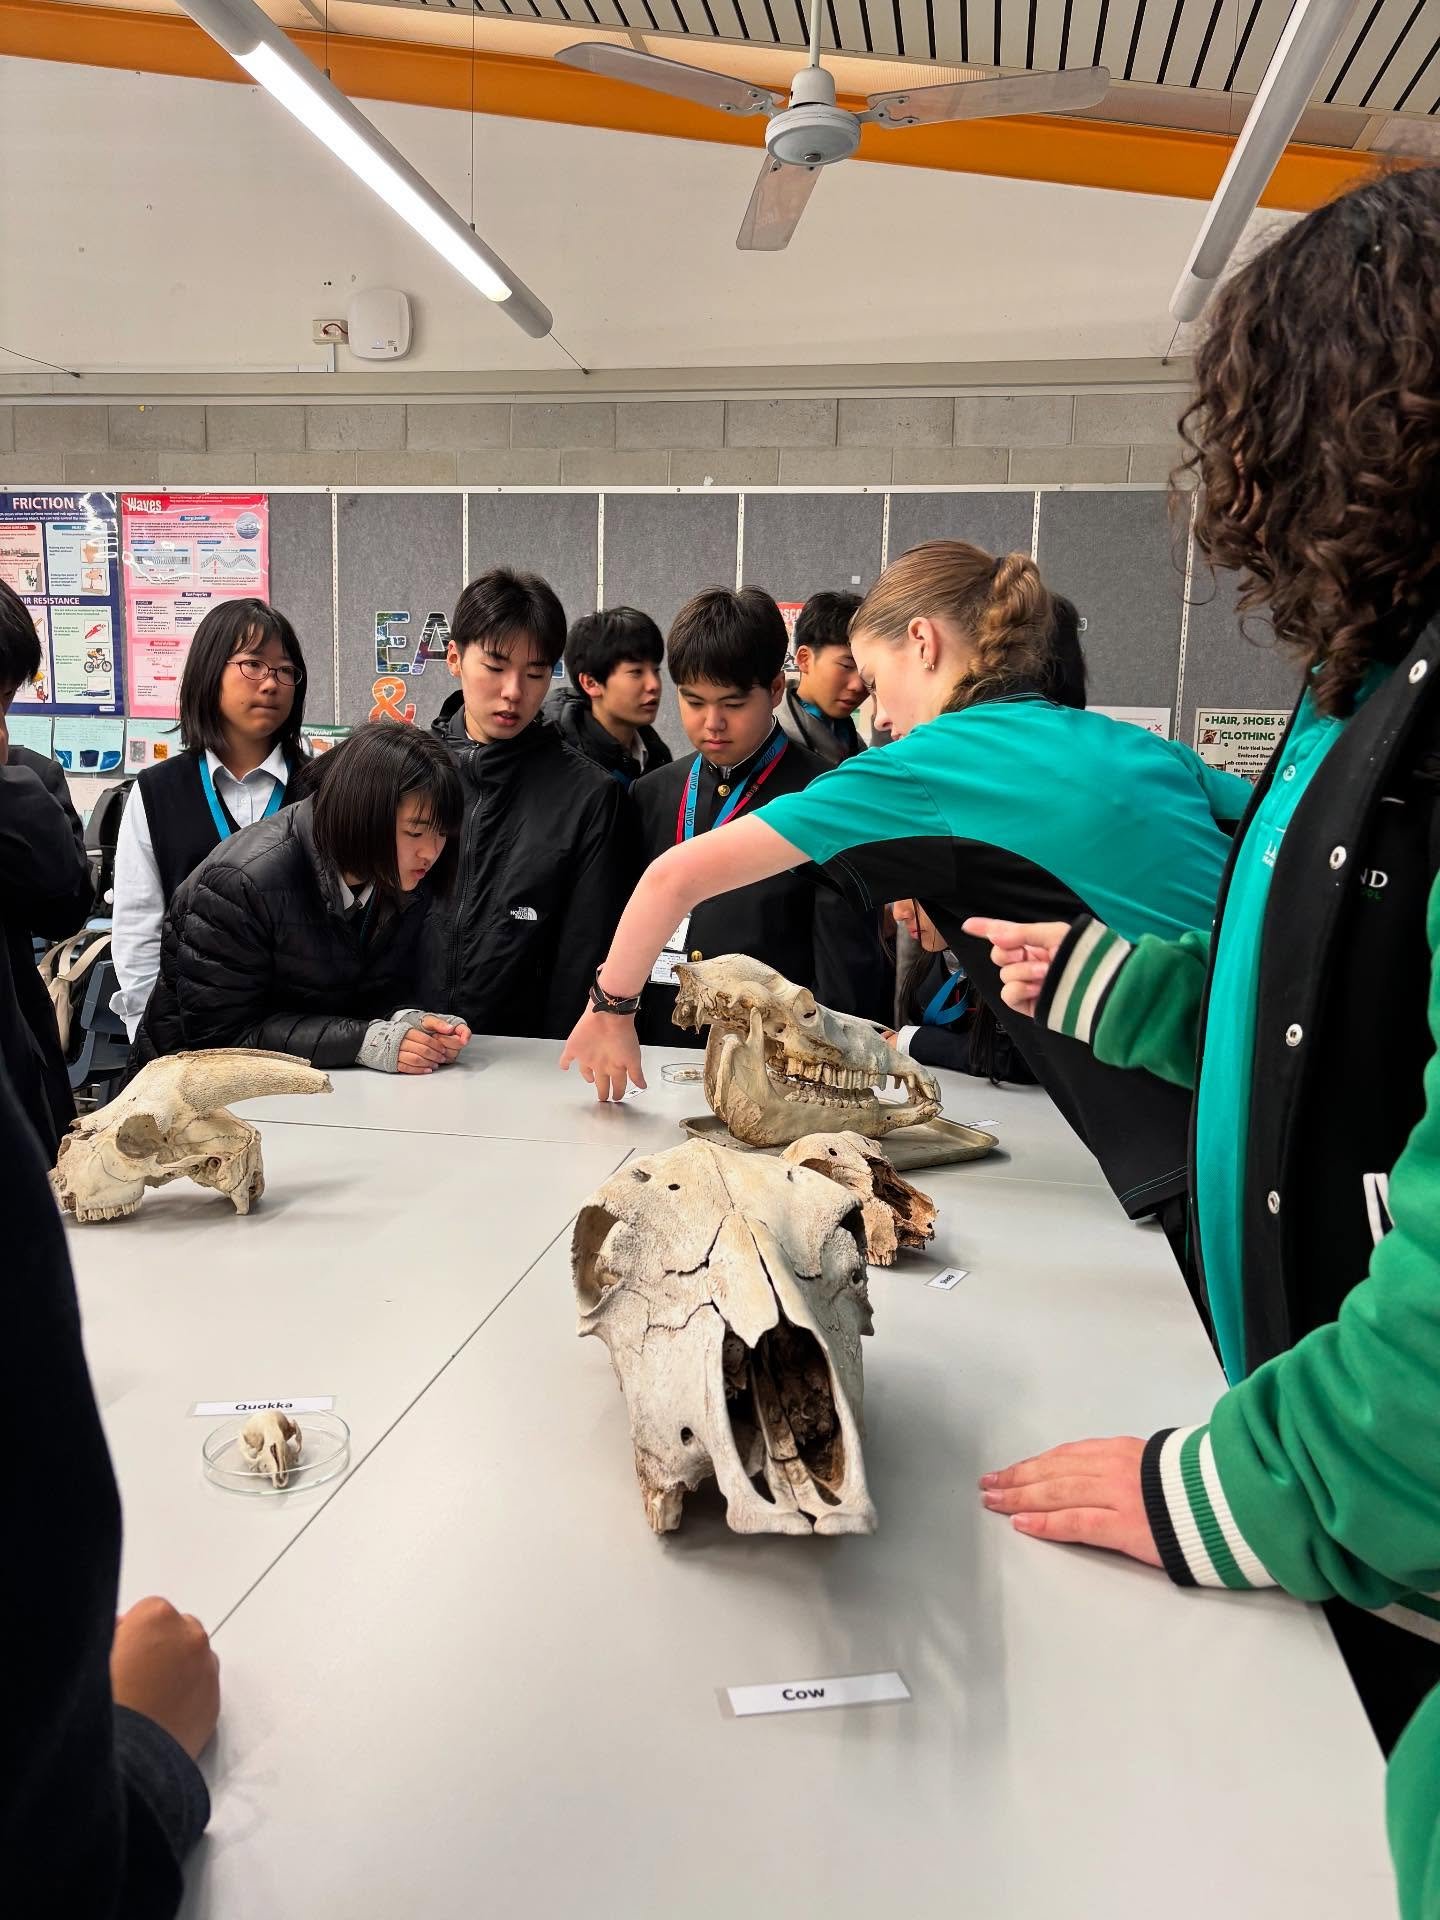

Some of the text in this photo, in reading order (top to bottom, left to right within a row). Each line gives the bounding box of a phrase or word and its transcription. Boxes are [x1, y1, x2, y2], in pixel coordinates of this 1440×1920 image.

[12, 497, 75, 510] FRICTION
[127, 497, 162, 511] Waves
[33, 597, 80, 605] RESISTANCE
[369, 676, 417, 724] &
[1211, 716, 1286, 726] HAIR, SHOES &
[1221, 731, 1276, 741] CLOTHING
[235, 1402, 293, 1411] Quokka
[782, 1687, 825, 1702] Cow
